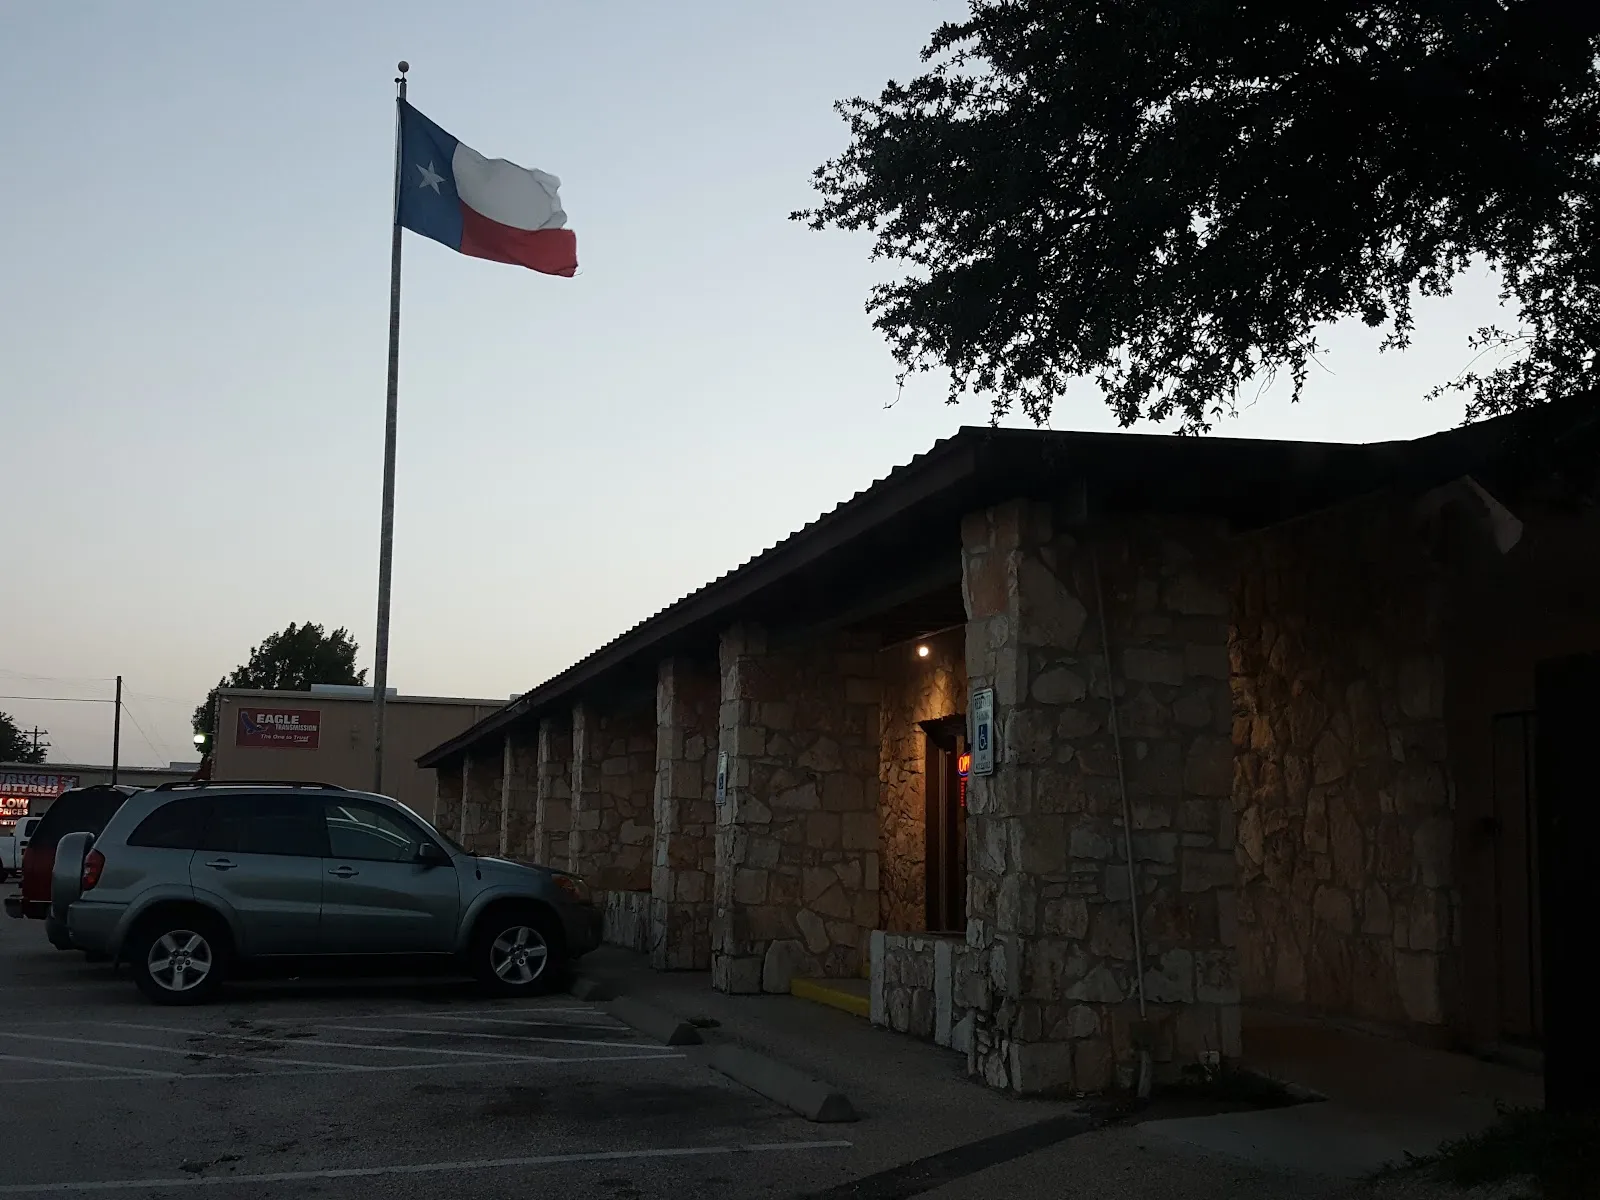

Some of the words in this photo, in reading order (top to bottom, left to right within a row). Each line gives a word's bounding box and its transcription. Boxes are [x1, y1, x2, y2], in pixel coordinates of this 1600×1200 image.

[256, 713, 300, 724] EAGLE
[0, 783, 58, 793] ATTRESS
[0, 797, 29, 808] LOW
